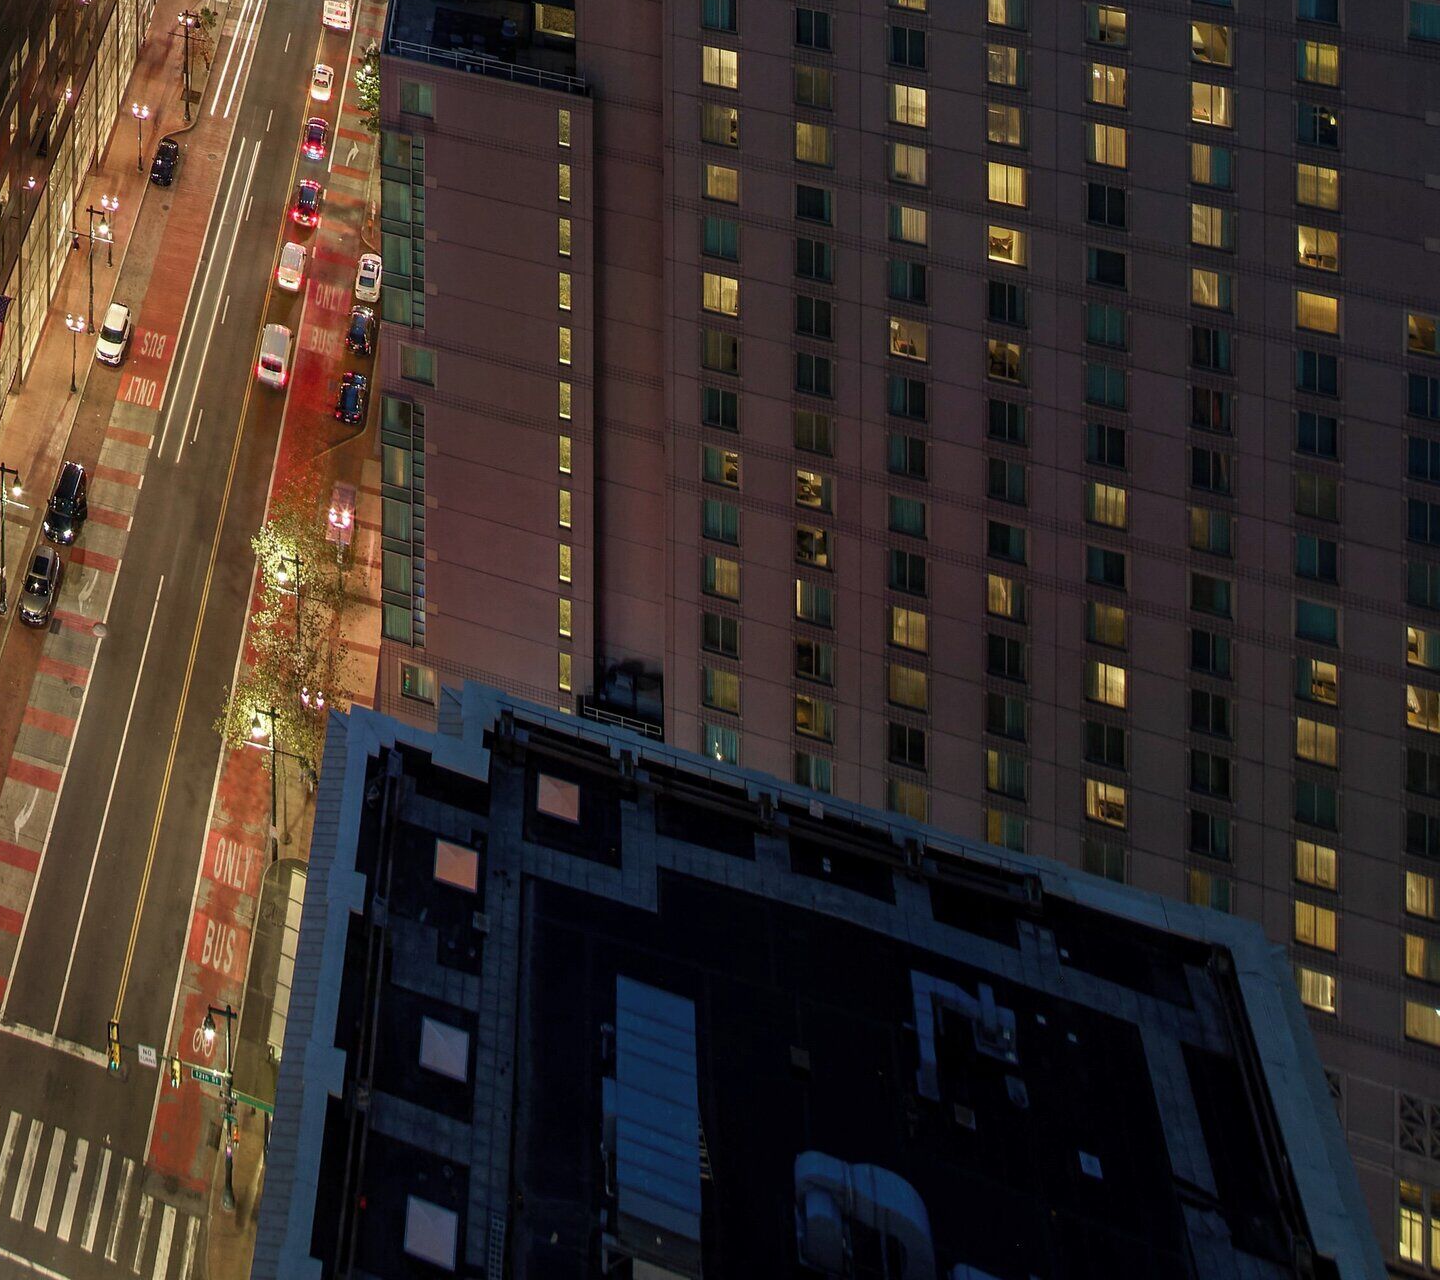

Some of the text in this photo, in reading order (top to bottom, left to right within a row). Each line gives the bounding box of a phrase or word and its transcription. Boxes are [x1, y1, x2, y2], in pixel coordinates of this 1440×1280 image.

[315, 283, 344, 311] ONLY
[142, 332, 166, 359] BUS
[310, 326, 339, 355] BUS
[124, 376, 157, 406] ONLY
[213, 837, 254, 891] ONLY
[201, 919, 237, 973] BUS
[142, 1047, 152, 1056] NO
